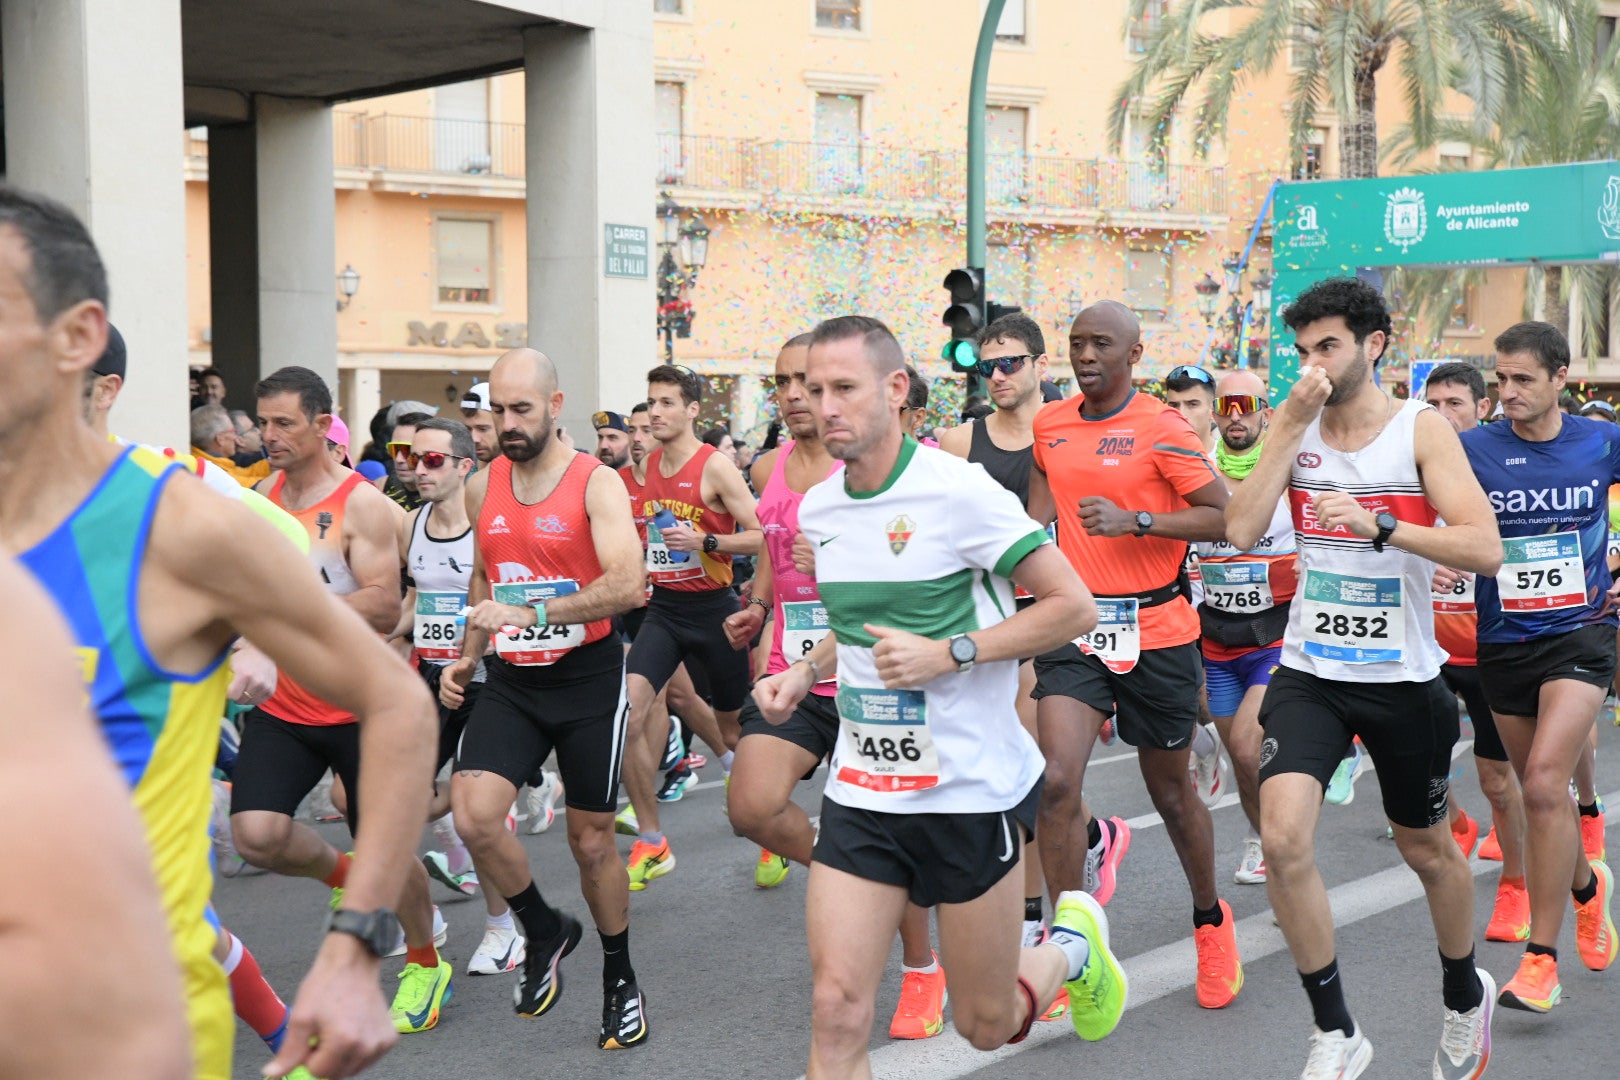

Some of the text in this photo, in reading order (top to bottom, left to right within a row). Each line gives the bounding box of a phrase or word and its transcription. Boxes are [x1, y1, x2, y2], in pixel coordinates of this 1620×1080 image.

[1436, 201, 1530, 219] Ayuntamiento
[1446, 216, 1519, 231] de Alicante
[614, 227, 646, 241] CARRER
[1096, 437, 1135, 456] 20 KM
[1505, 457, 1527, 466] GOBIK
[1487, 483, 1595, 514] saxun
[1529, 516, 1559, 524] nuestro
[1516, 568, 1563, 590] 576
[1214, 590, 1263, 608] 2768
[422, 623, 456, 641] 286
[1315, 612, 1389, 639] 2832
